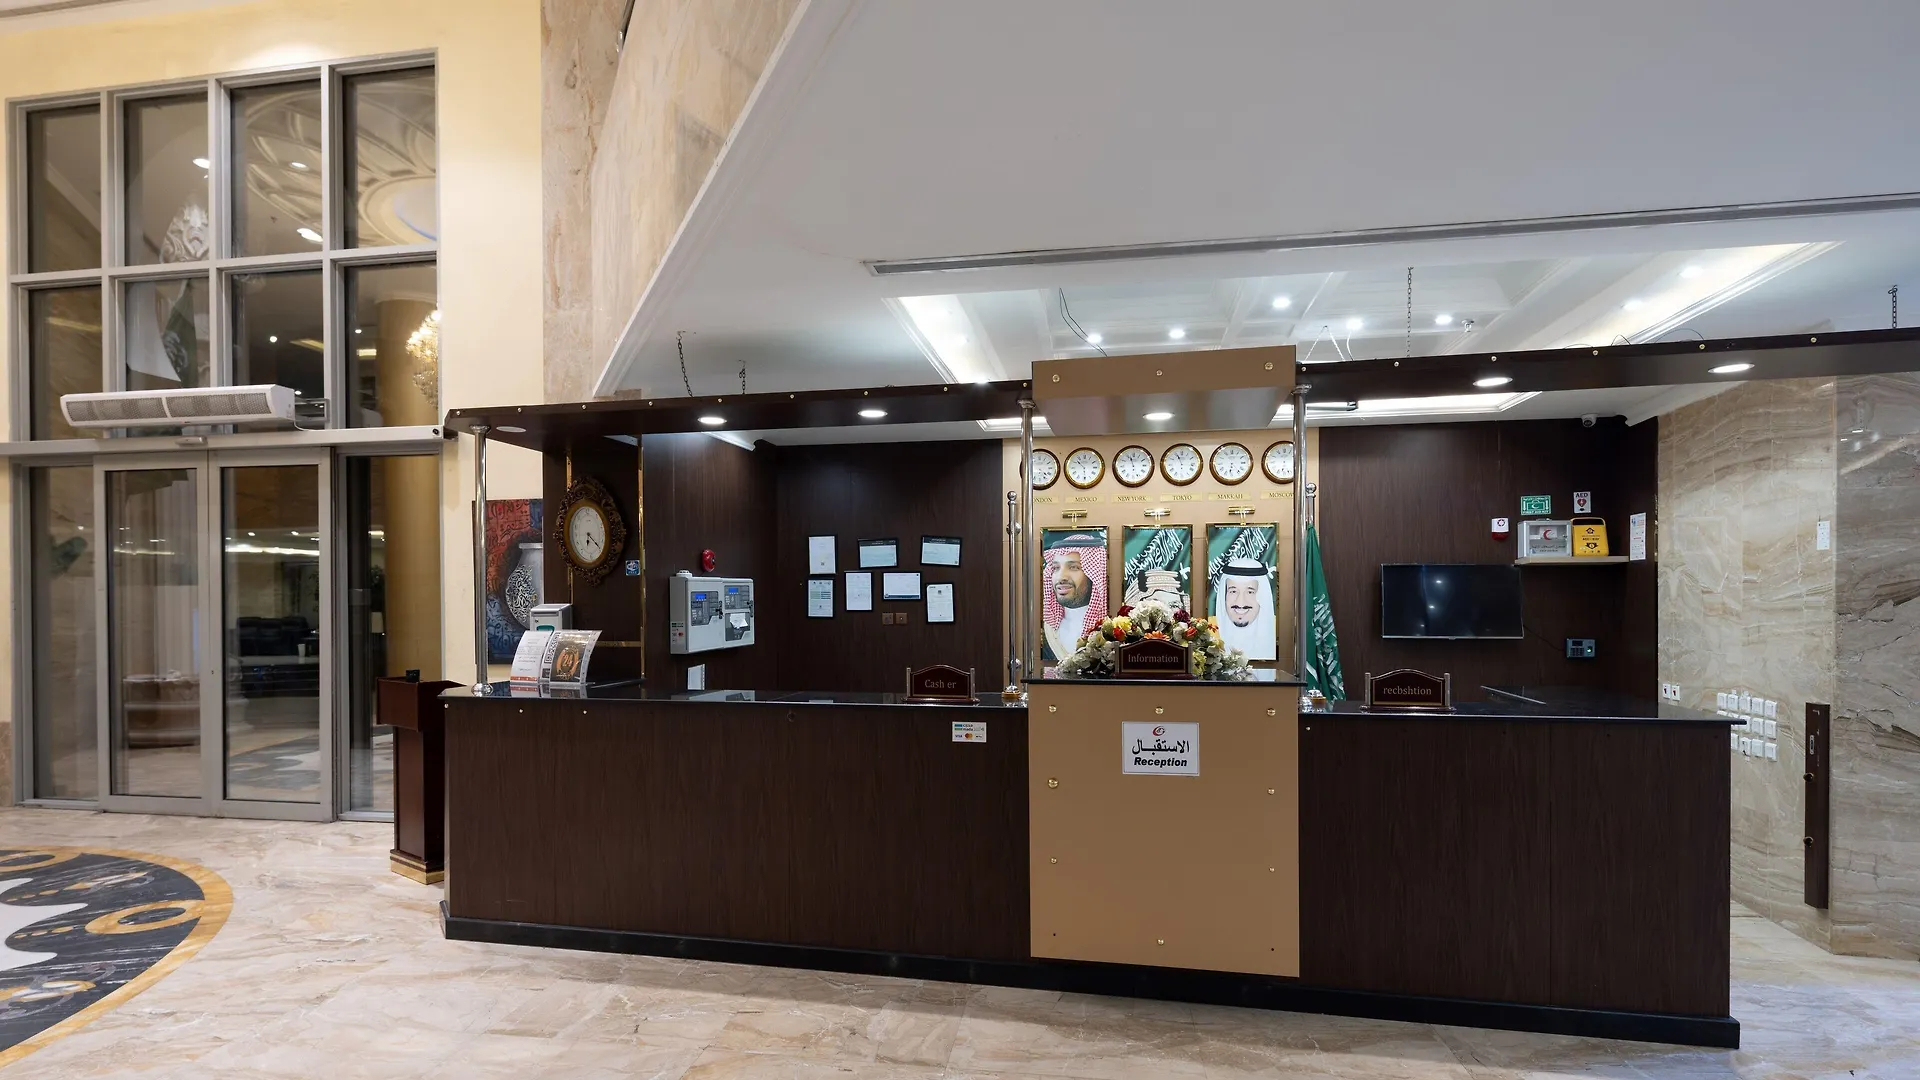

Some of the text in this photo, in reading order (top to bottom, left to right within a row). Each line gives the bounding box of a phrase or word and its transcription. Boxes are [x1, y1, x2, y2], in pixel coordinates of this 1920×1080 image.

[562, 652, 574, 667] 24
[1128, 653, 1179, 663] Information
[1131, 738, 1190, 756] الاستقبال
[1133, 756, 1188, 768] Reception
